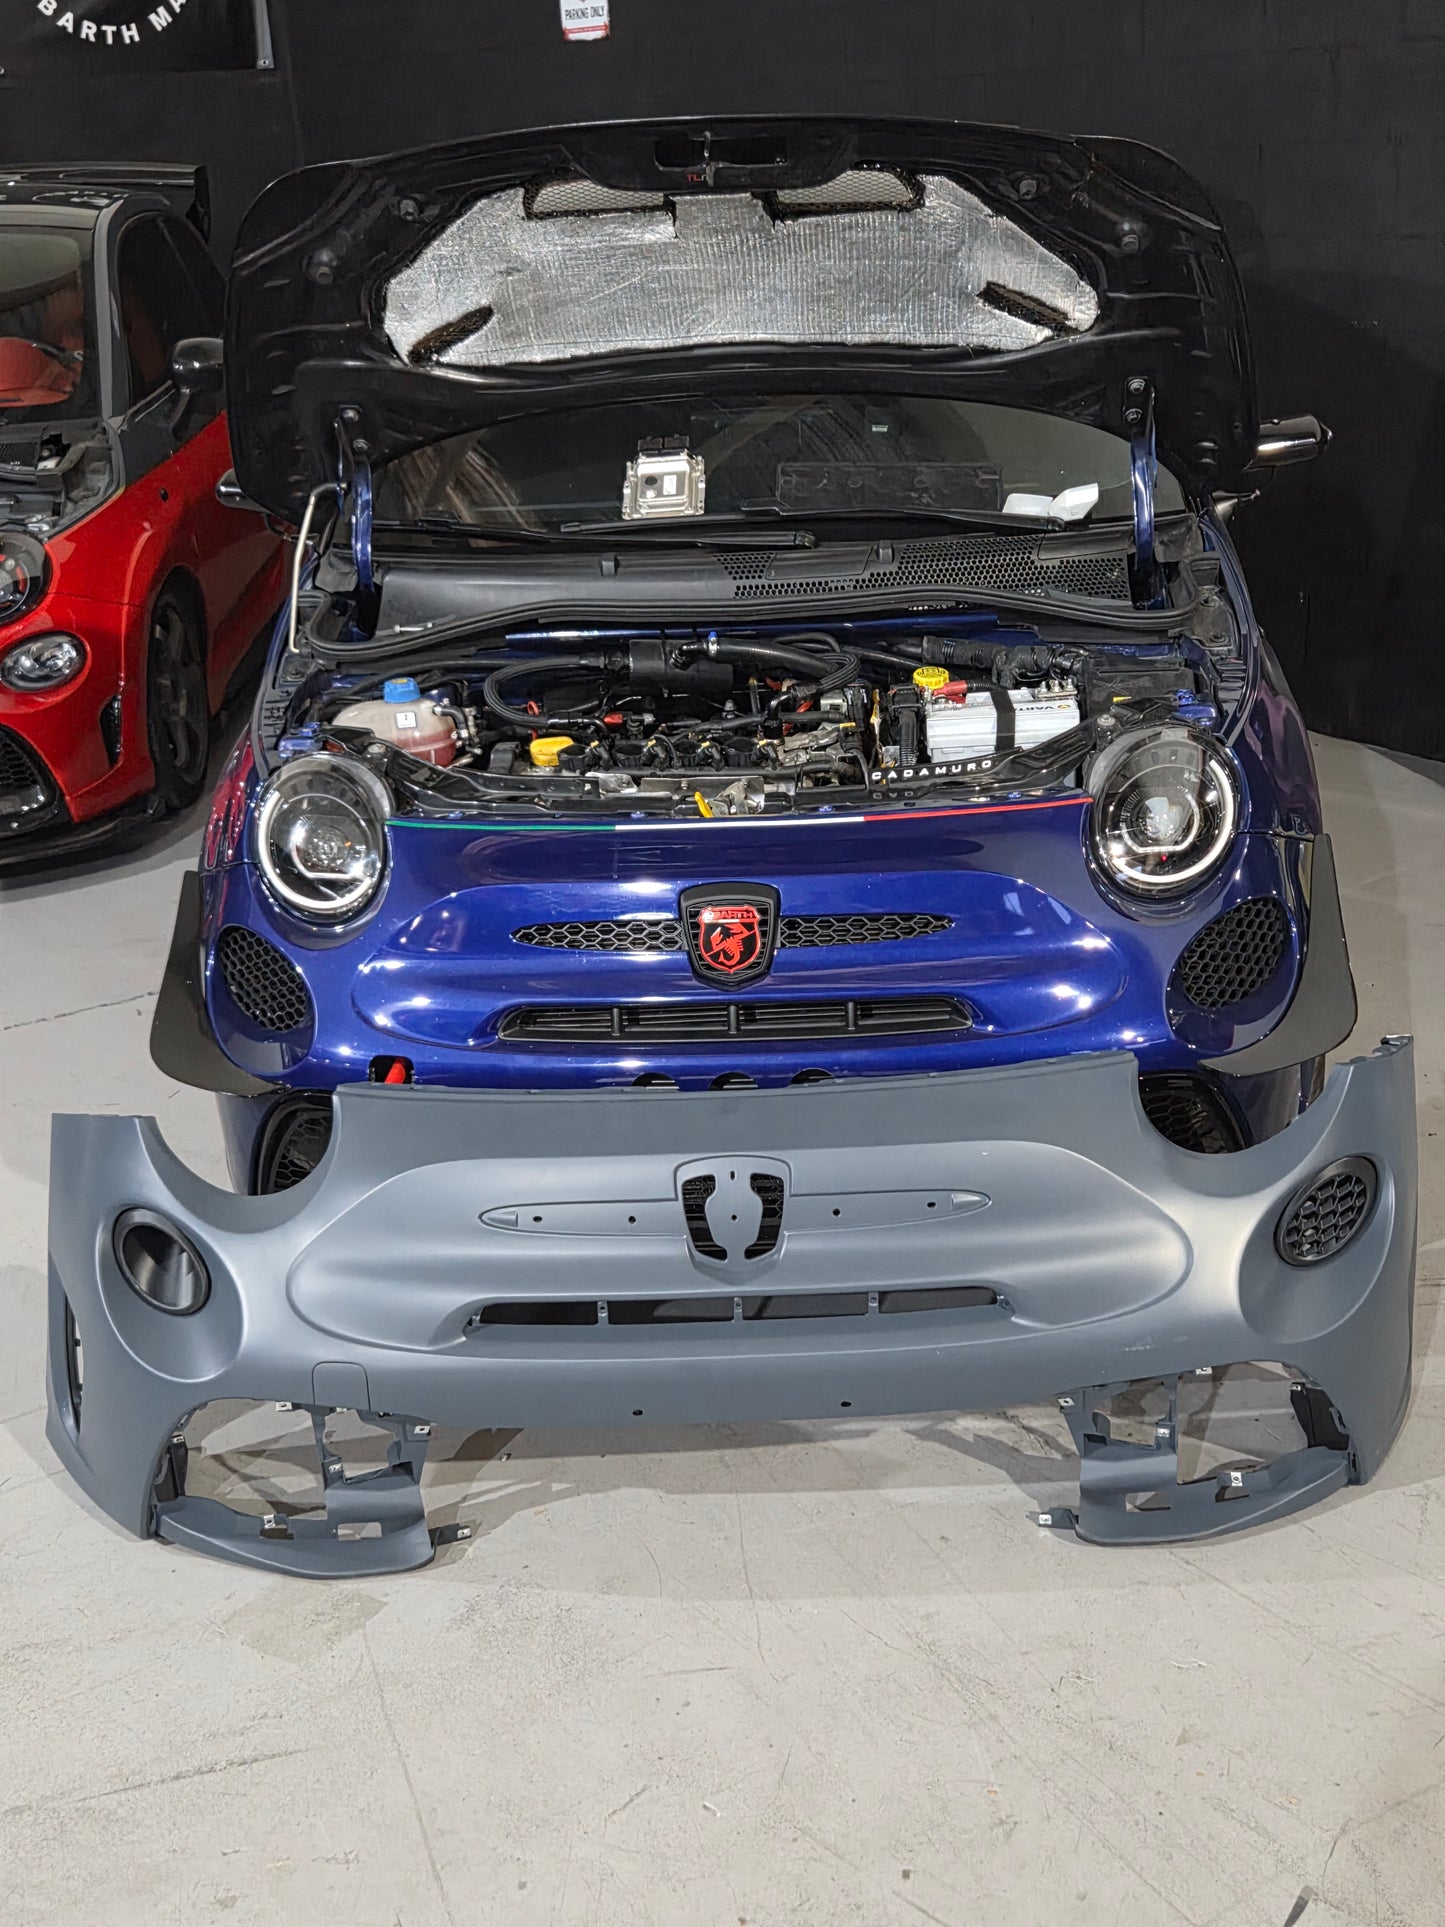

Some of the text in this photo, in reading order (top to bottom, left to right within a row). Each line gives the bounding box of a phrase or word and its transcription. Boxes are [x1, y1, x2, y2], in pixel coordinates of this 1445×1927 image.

[565, 6, 605, 20] PARKING ONLY
[871, 760, 992, 780] CADAMURO
